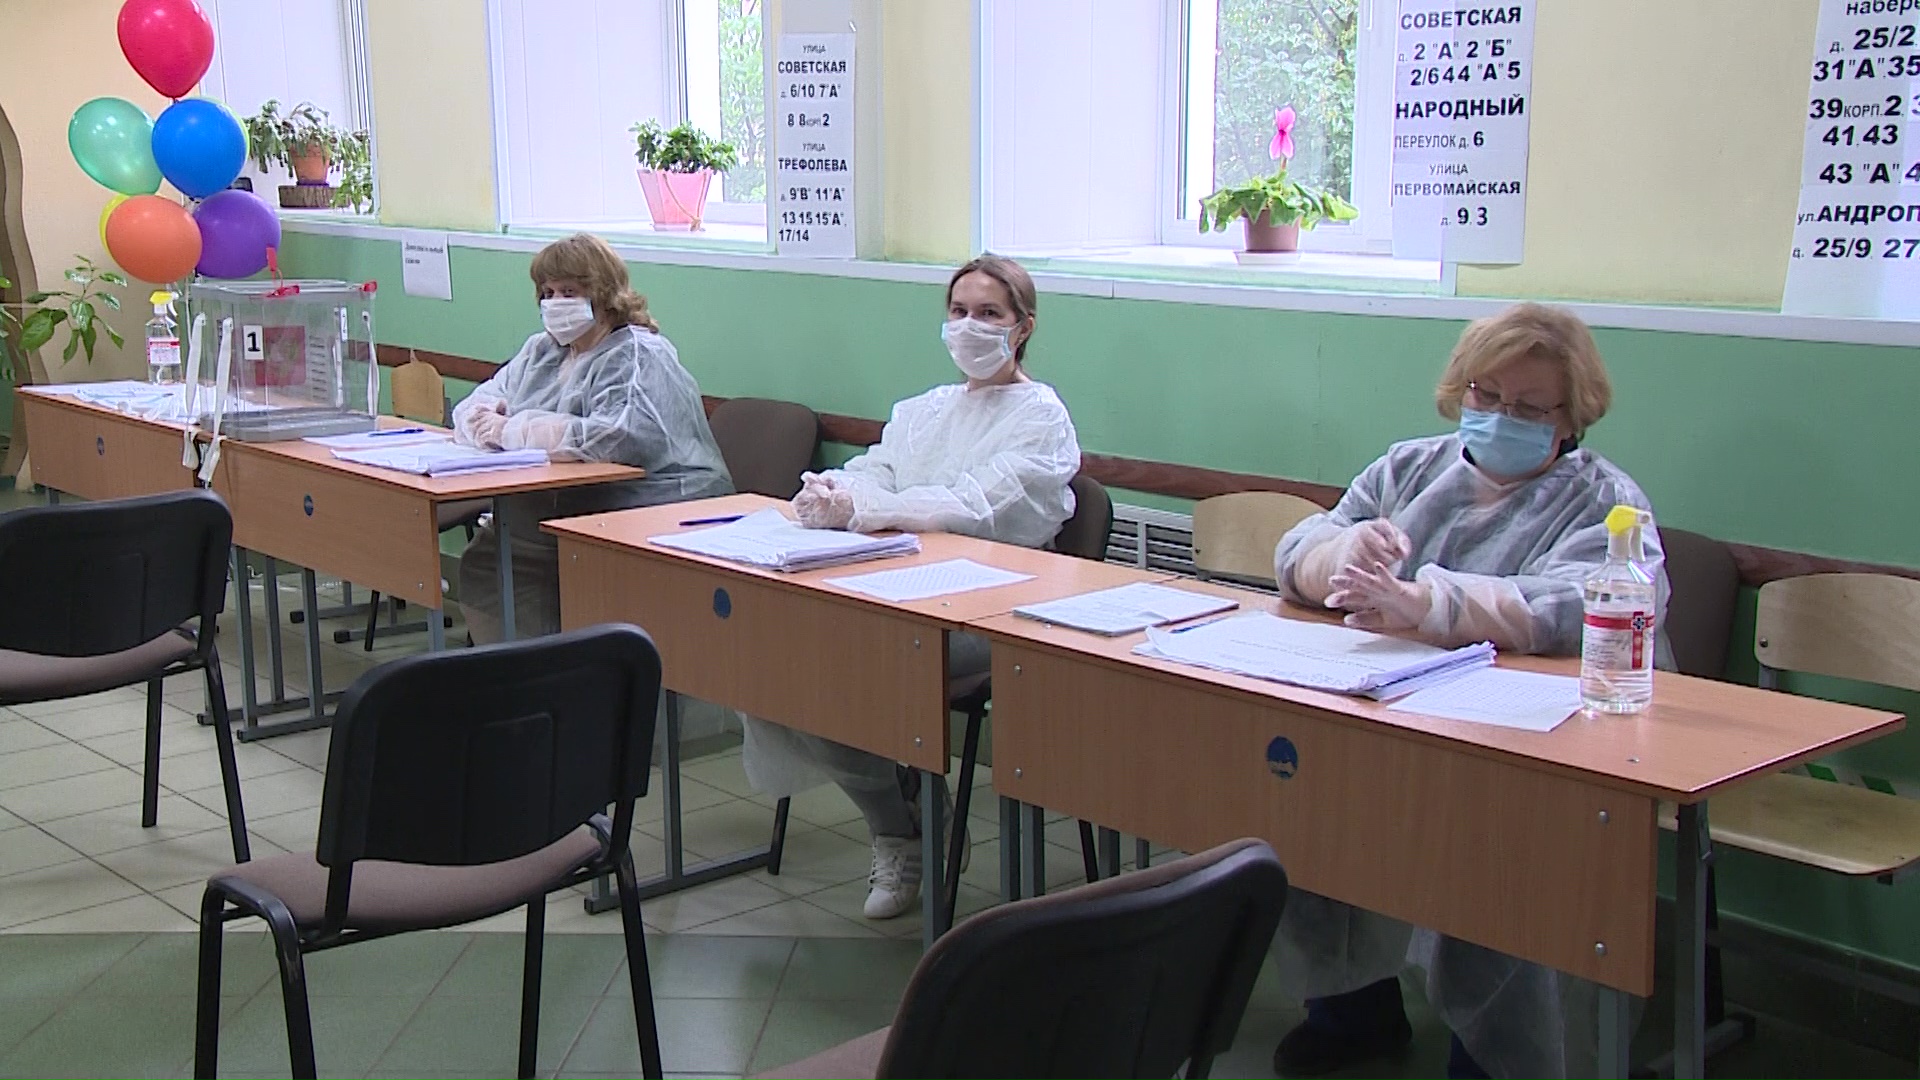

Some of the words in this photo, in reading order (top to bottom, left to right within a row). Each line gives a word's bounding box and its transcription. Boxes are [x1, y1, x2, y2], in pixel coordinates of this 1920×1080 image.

[1400, 6, 1522, 30] СОВЕТСКАЯ
[802, 44, 826, 54] УЛИЦА
[1414, 43, 1425, 60] 2
[1466, 41, 1479, 58] 2
[777, 60, 847, 74] СОВЕТСКАЯ
[790, 83, 815, 98] 6/10
[1395, 93, 1525, 120] НАРОДНЫЙ
[787, 113, 795, 127] 8
[1394, 135, 1456, 148] ПЕРЕУЛОК
[1473, 130, 1485, 147] 6
[802, 143, 826, 152] УЛИЦА
[778, 157, 848, 172] ТРЕФОЛЕВА
[1429, 163, 1469, 175] УЛИЦА
[1819, 163, 1852, 184] 43
[1394, 179, 1521, 196] ПЕРВОМАЙСКАЯ
[782, 211, 796, 225] 13
[1477, 206, 1488, 226] 3
[778, 229, 810, 242] 17/14
[246, 331, 261, 353] 1
